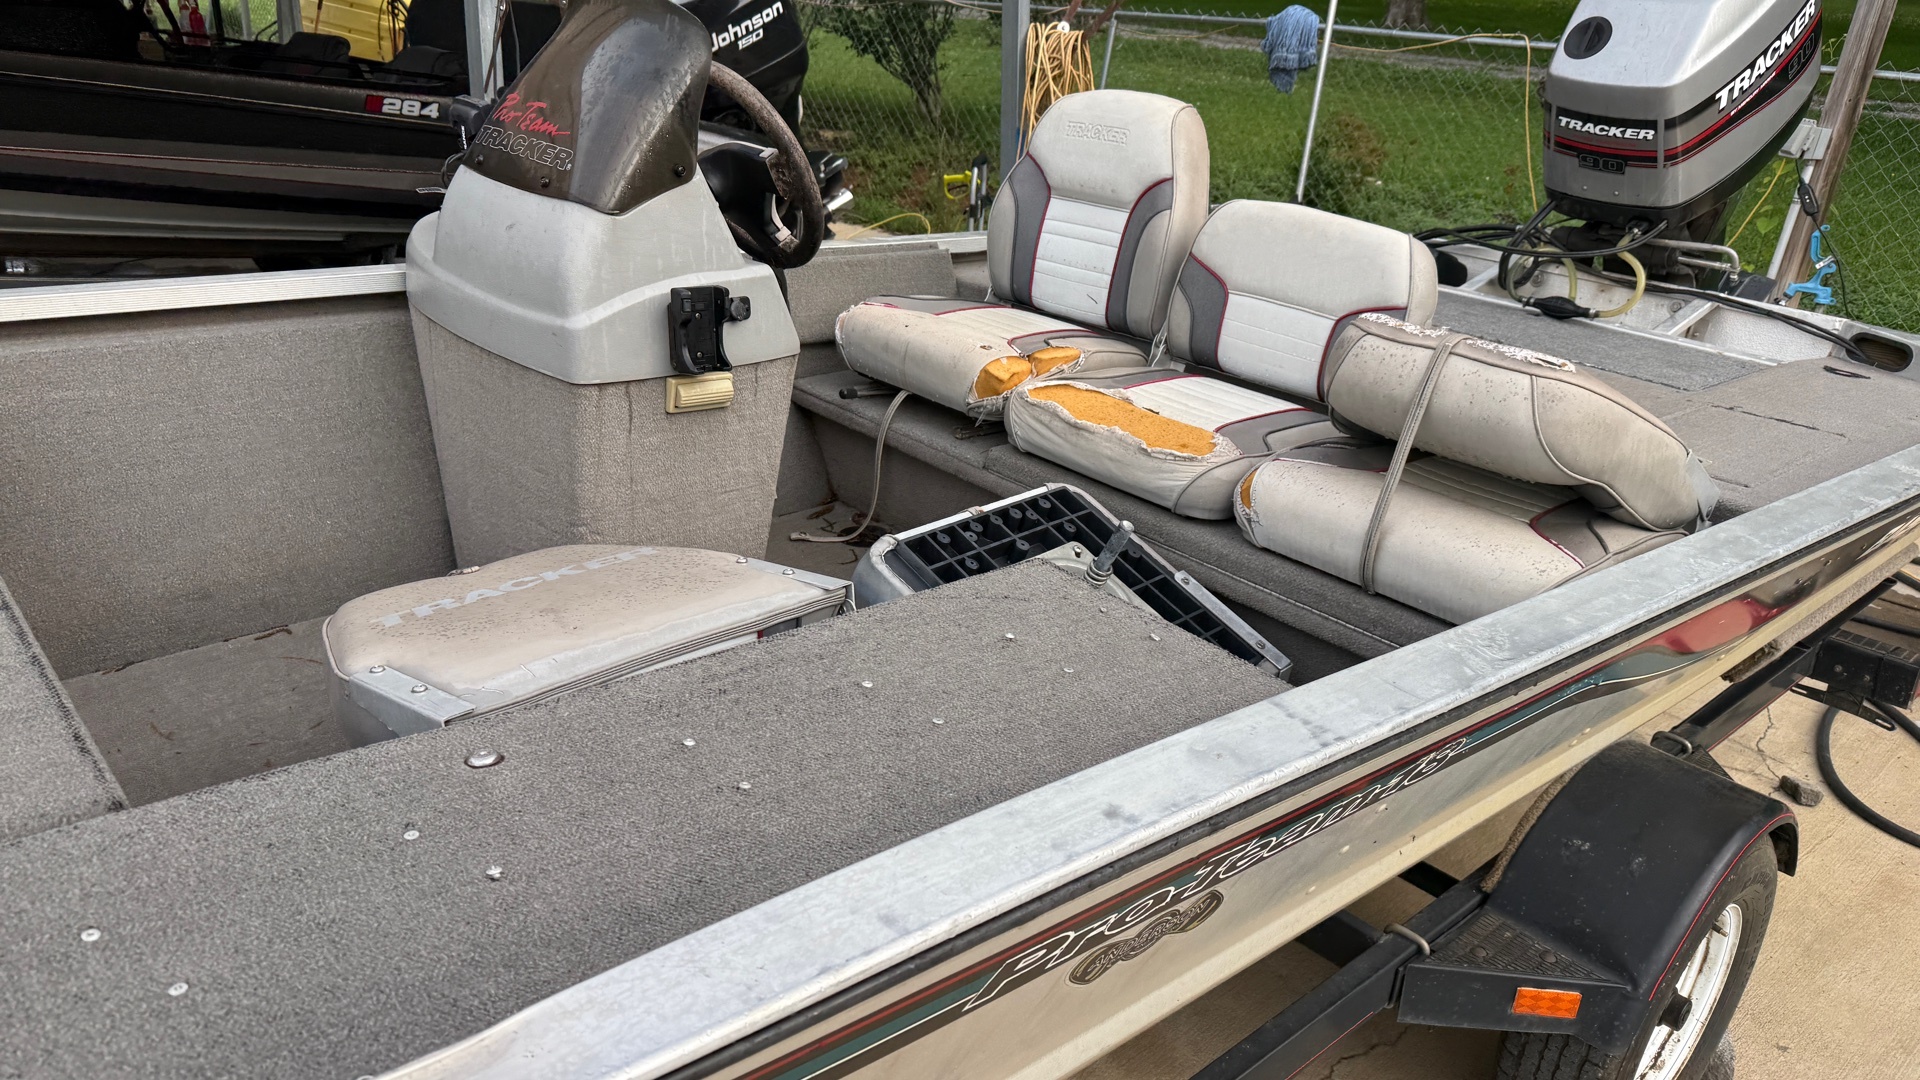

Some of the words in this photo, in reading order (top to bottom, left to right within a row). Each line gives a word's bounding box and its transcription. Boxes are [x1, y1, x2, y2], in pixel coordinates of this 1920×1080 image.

[711, 1, 784, 53] Johnson
[737, 27, 764, 51] 150
[1715, 0, 1816, 111] TRACKER
[382, 97, 439, 119] 284
[1065, 121, 1131, 146] TRACKER
[1558, 116, 1656, 140] TRACKER
[475, 124, 573, 171] TRACKER
[1579, 153, 1626, 174] 90
[369, 546, 658, 628] TRACKER
